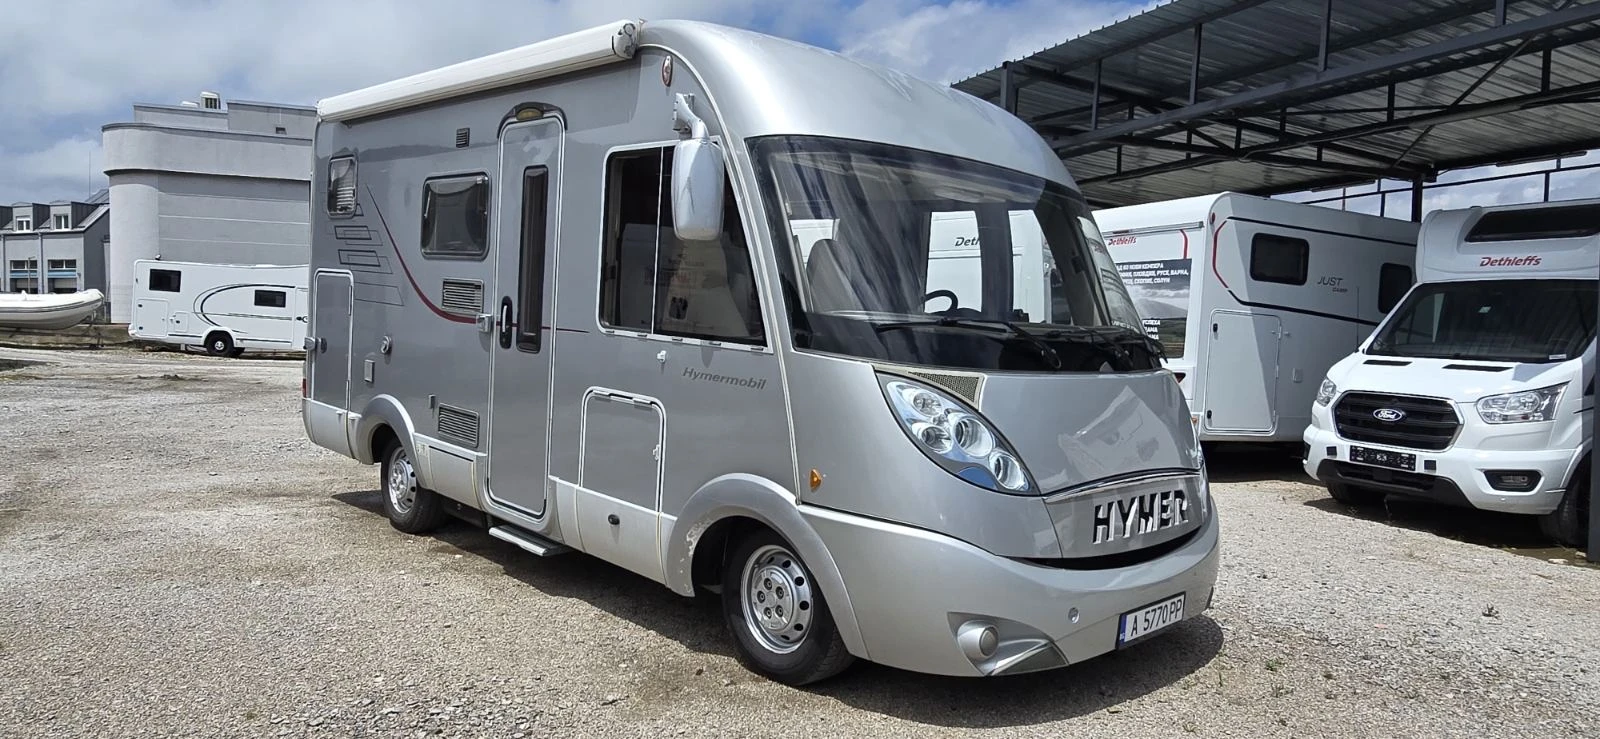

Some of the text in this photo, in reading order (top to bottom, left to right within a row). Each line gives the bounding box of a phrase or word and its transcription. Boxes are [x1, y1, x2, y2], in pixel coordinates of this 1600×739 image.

[1480, 255, 1542, 267] Dethleffs
[1317, 276, 1344, 286] JUST
[682, 366, 767, 390] Hymermobil
[1376, 410, 1398, 420] Ford
[1093, 489, 1189, 544] HYMER
[1130, 615, 1138, 637] A
